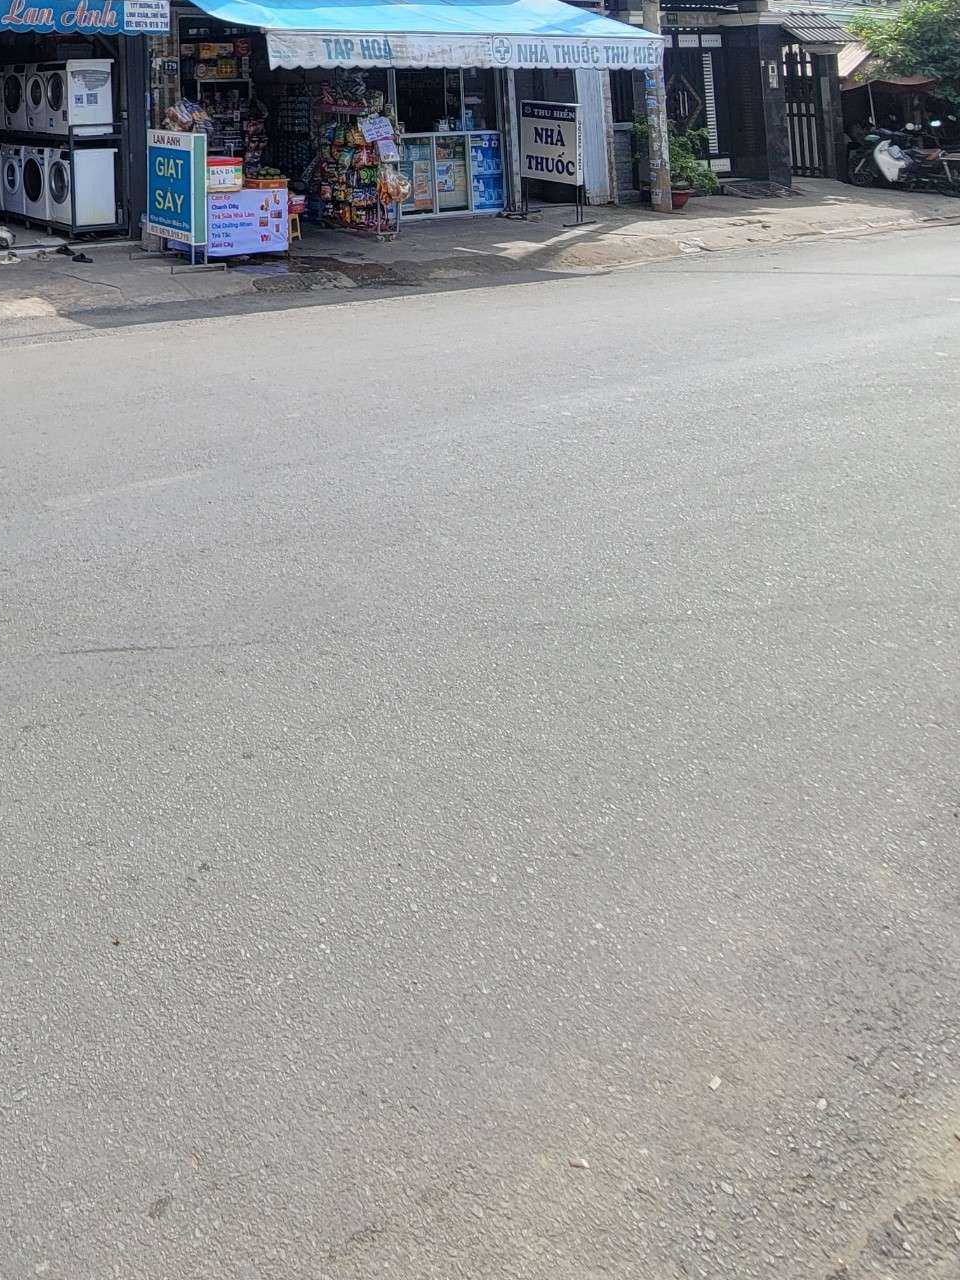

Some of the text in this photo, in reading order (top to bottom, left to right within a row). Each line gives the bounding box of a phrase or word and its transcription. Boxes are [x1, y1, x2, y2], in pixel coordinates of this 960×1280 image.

[60, 0, 121, 27] Anh
[517, 40, 550, 64] NHÀ
[553, 38, 600, 65] THUỐC
[604, 45, 630, 64] THU
[533, 107, 551, 118] THU
[152, 134, 181, 147] LAN ANH
[534, 123, 566, 148] NHÀ
[155, 154, 185, 184] GIẶT
[526, 151, 575, 177] THUỐC
[155, 186, 185, 214] SẤY
